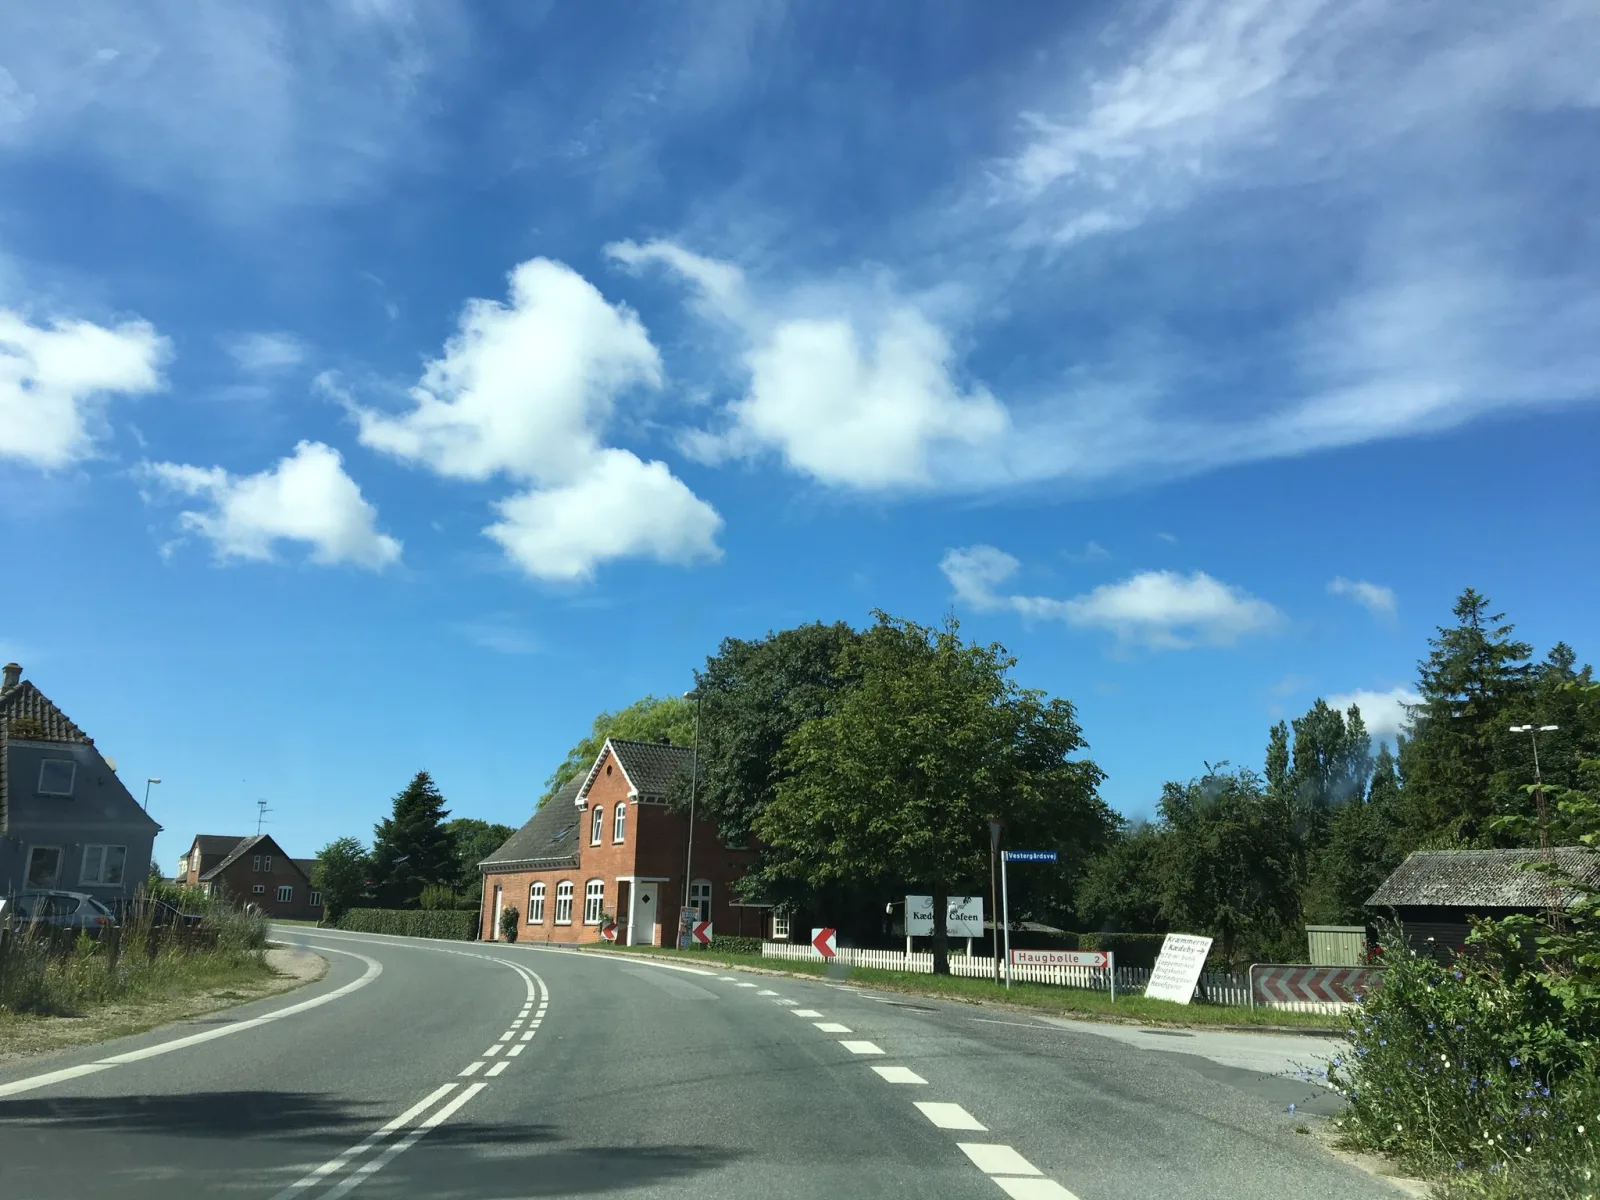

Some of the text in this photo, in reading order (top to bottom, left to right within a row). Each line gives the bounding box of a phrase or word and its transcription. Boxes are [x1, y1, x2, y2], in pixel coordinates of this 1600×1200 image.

[1008, 852, 1057, 861] Vestergårdsvej
[913, 911, 978, 921] Kæd Cafeen
[1168, 944, 1196, 953] Kædeby
[1018, 953, 1079, 963] Haugbølle
